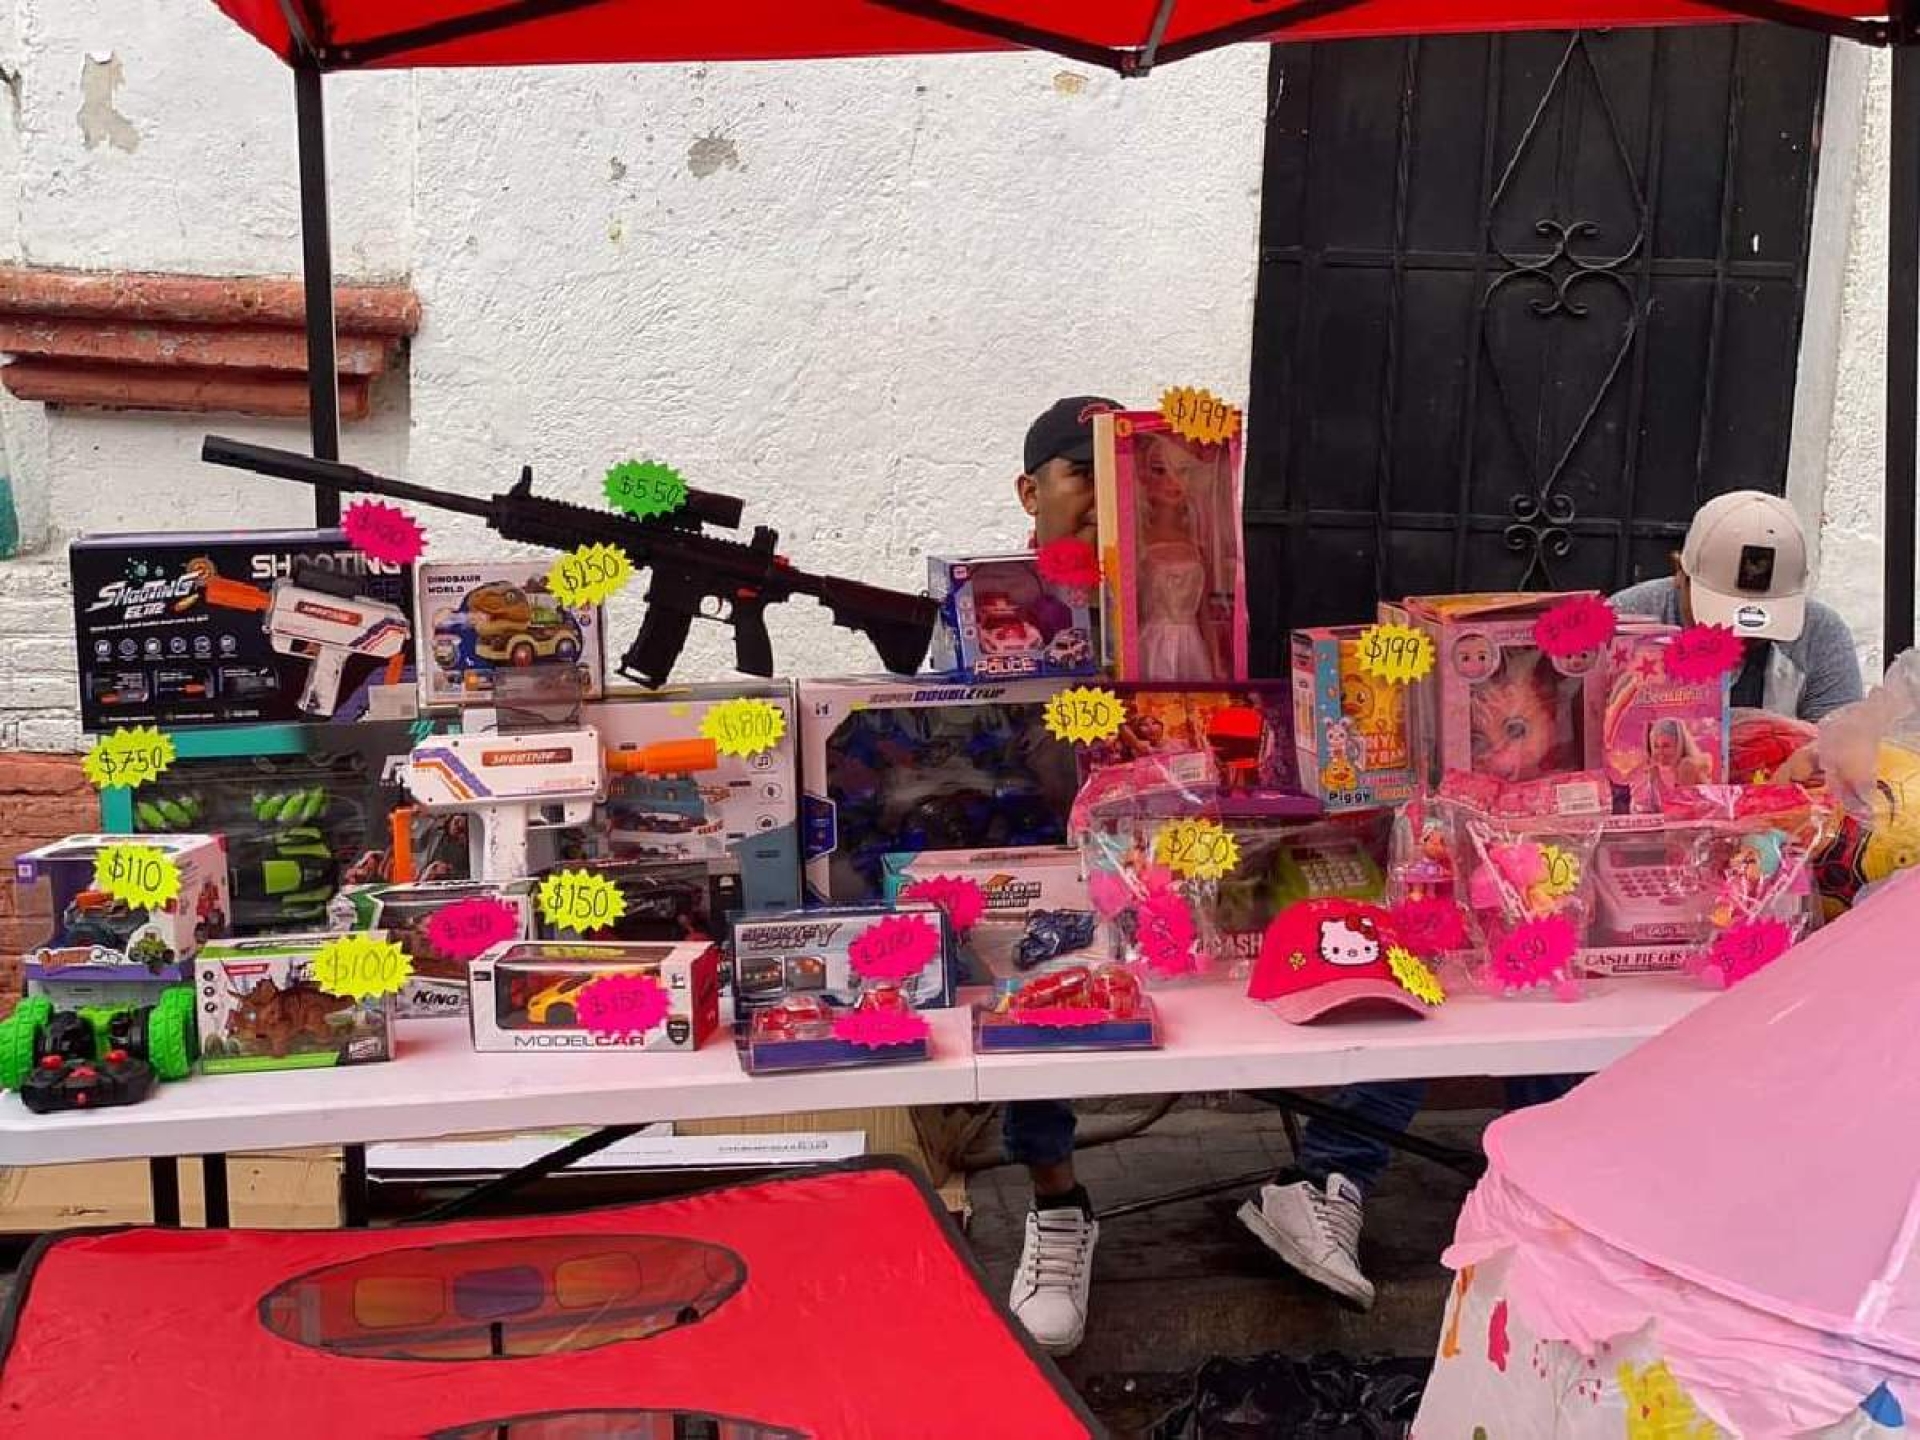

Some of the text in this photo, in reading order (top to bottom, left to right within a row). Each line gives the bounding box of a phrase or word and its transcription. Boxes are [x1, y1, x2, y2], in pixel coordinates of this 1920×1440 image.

[1171, 396, 1228, 431] $199
[619, 474, 680, 505] $550
[427, 575, 481, 583] DINOSAUR
[428, 586, 464, 594] WORLD
[561, 553, 620, 594] $250
[974, 655, 1038, 675] POLICE
[1365, 633, 1420, 668] $199
[1055, 700, 1110, 728] $130
[99, 750, 163, 782] $750
[1167, 828, 1230, 866] $250
[107, 850, 163, 892] $110
[547, 884, 610, 919] $150
[326, 949, 398, 984] $100
